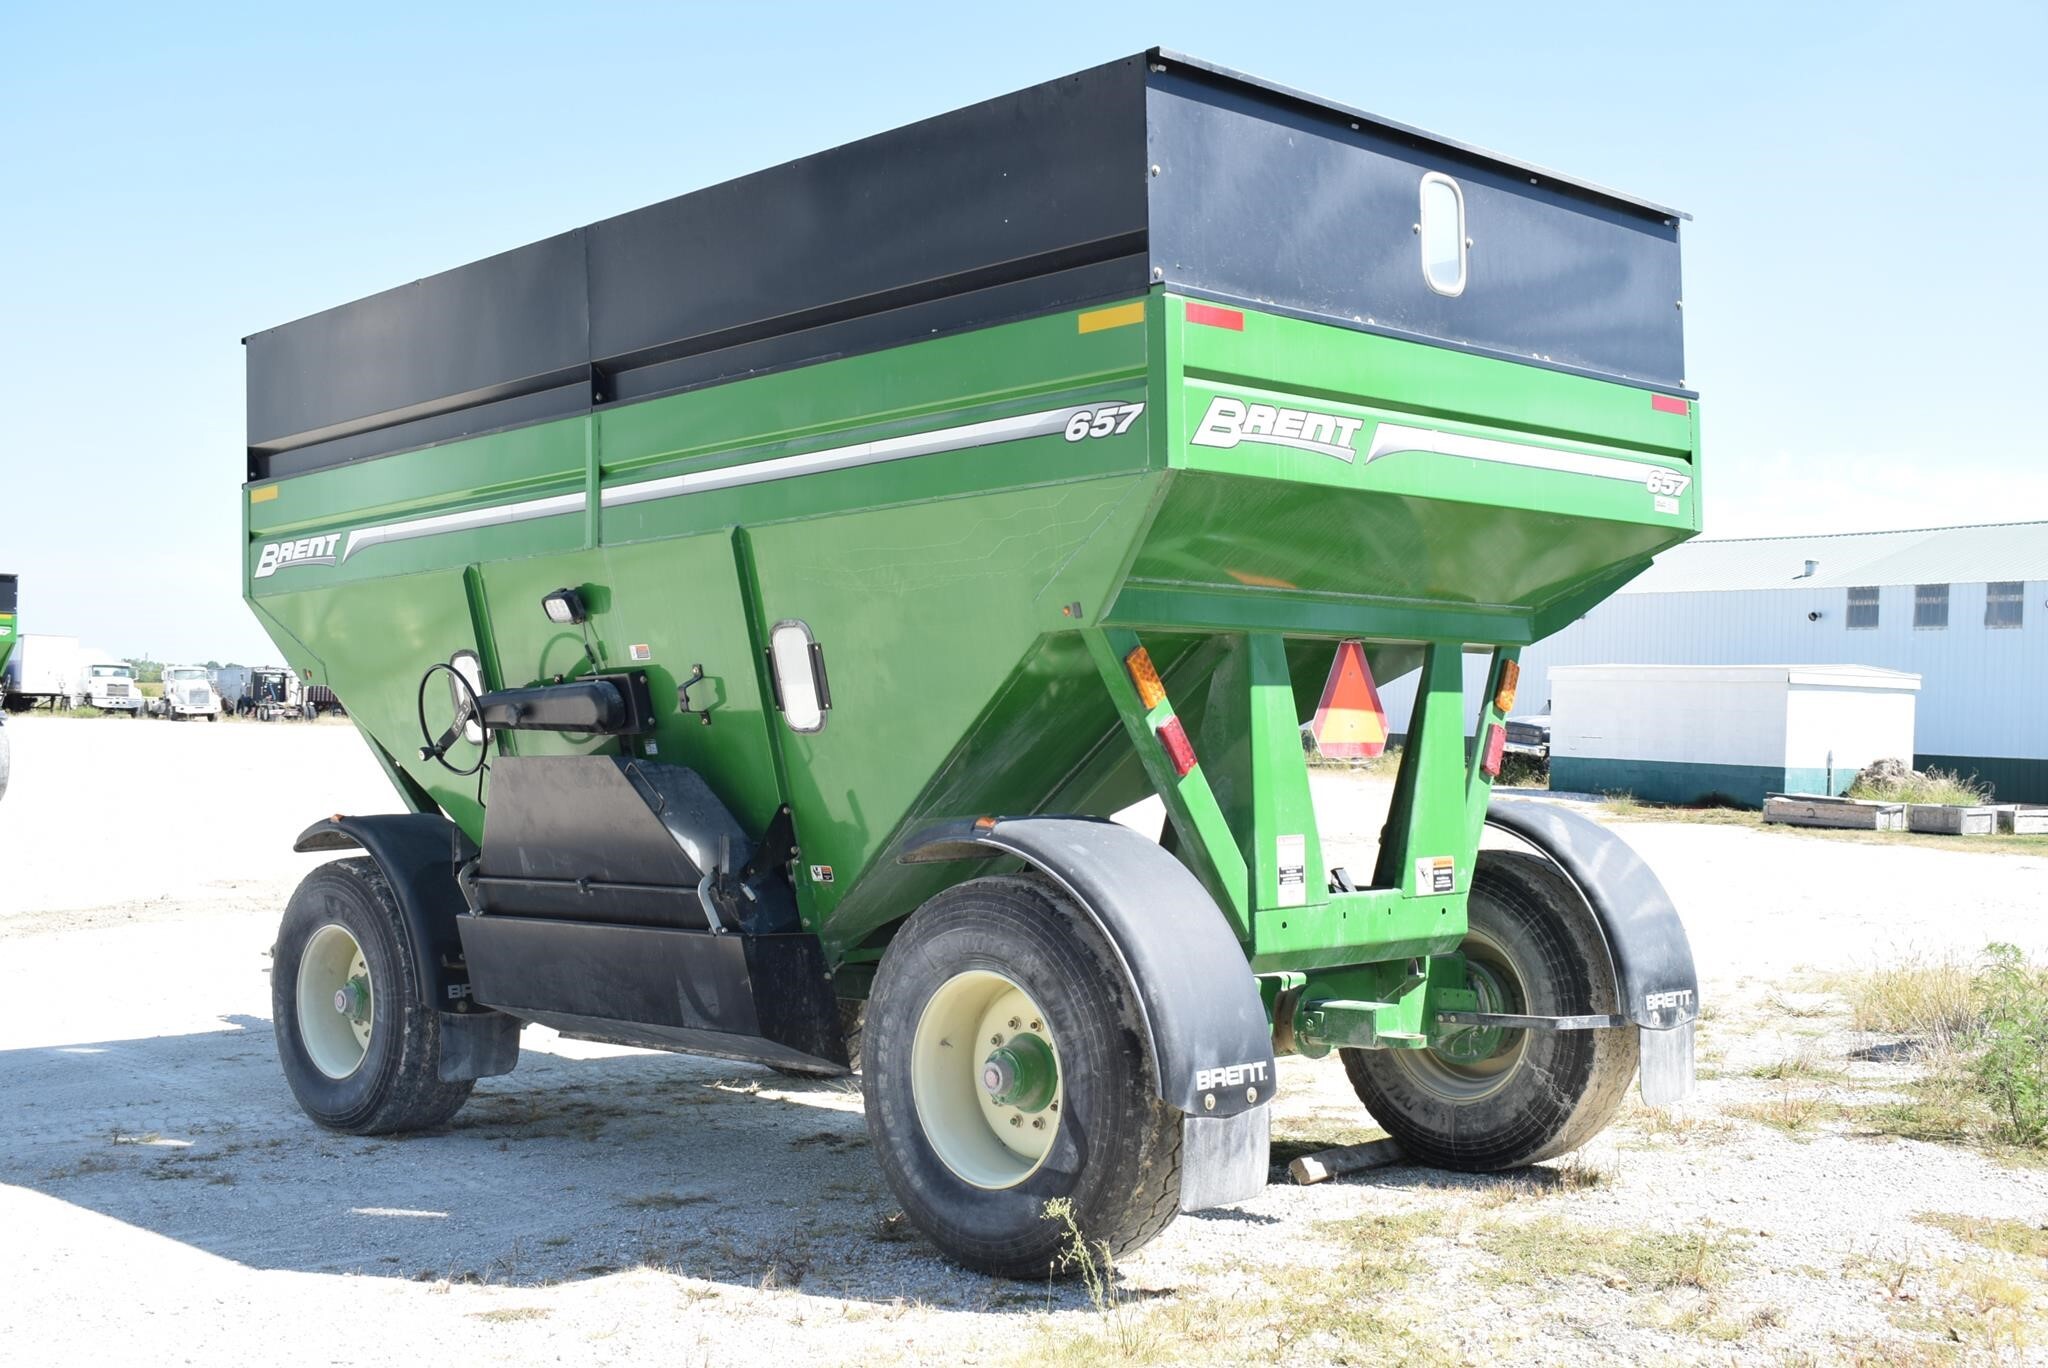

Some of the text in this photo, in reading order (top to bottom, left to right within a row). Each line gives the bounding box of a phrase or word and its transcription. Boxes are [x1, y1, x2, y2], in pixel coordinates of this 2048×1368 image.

[1064, 401, 1146, 443] 657
[1190, 396, 1364, 452] BRENT
[1647, 470, 1691, 497] 657
[254, 533, 342, 578] BRENT
[1646, 990, 1692, 1010] BRENT
[1196, 1061, 1267, 1091] BRENT
